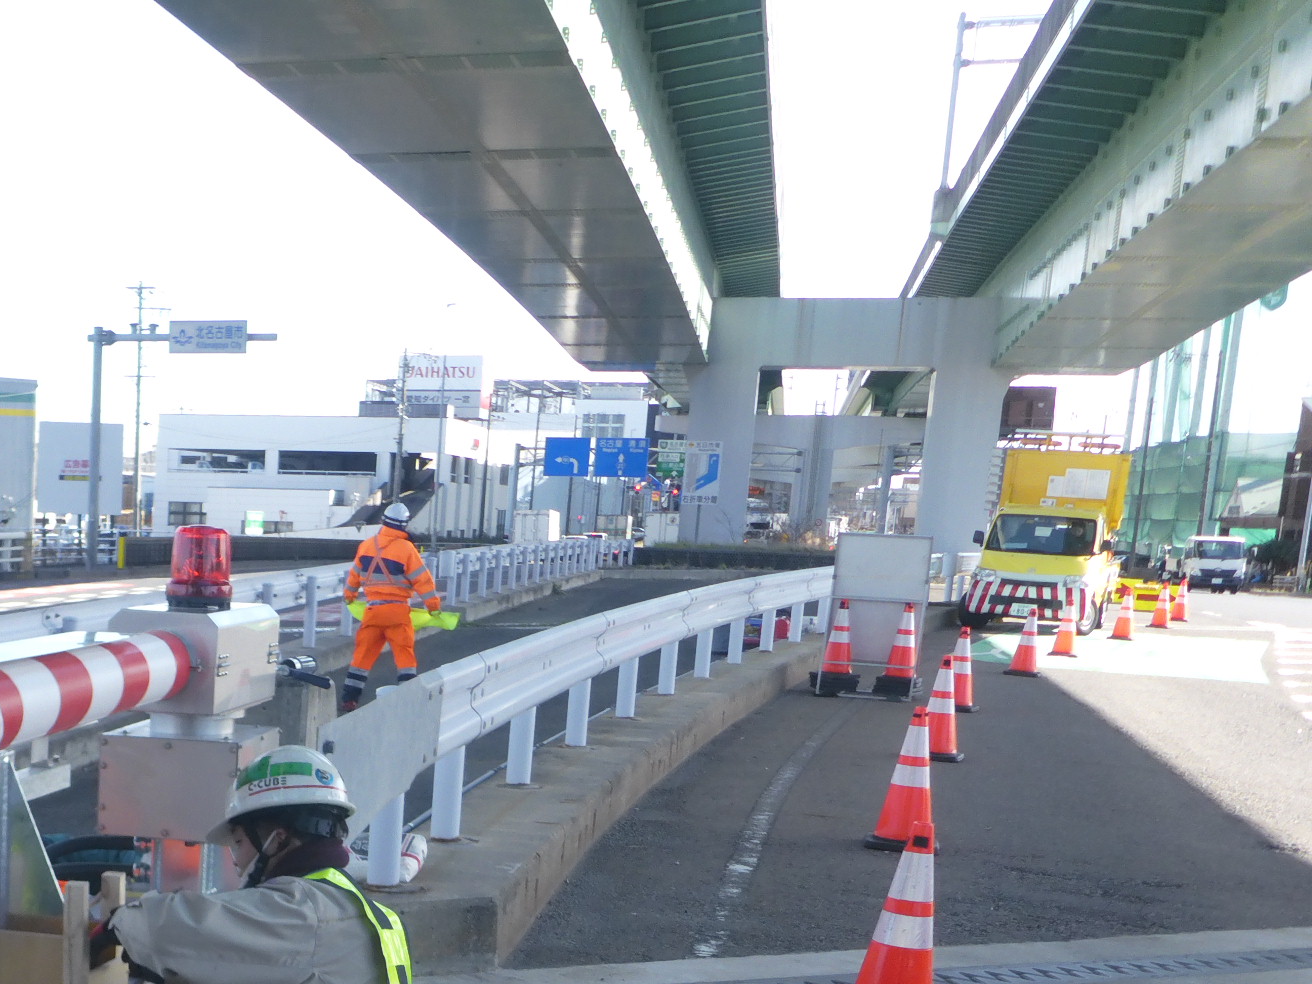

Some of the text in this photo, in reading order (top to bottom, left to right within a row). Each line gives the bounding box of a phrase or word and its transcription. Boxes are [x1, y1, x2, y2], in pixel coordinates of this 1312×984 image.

[196, 325, 243, 339] 北名古屋市
